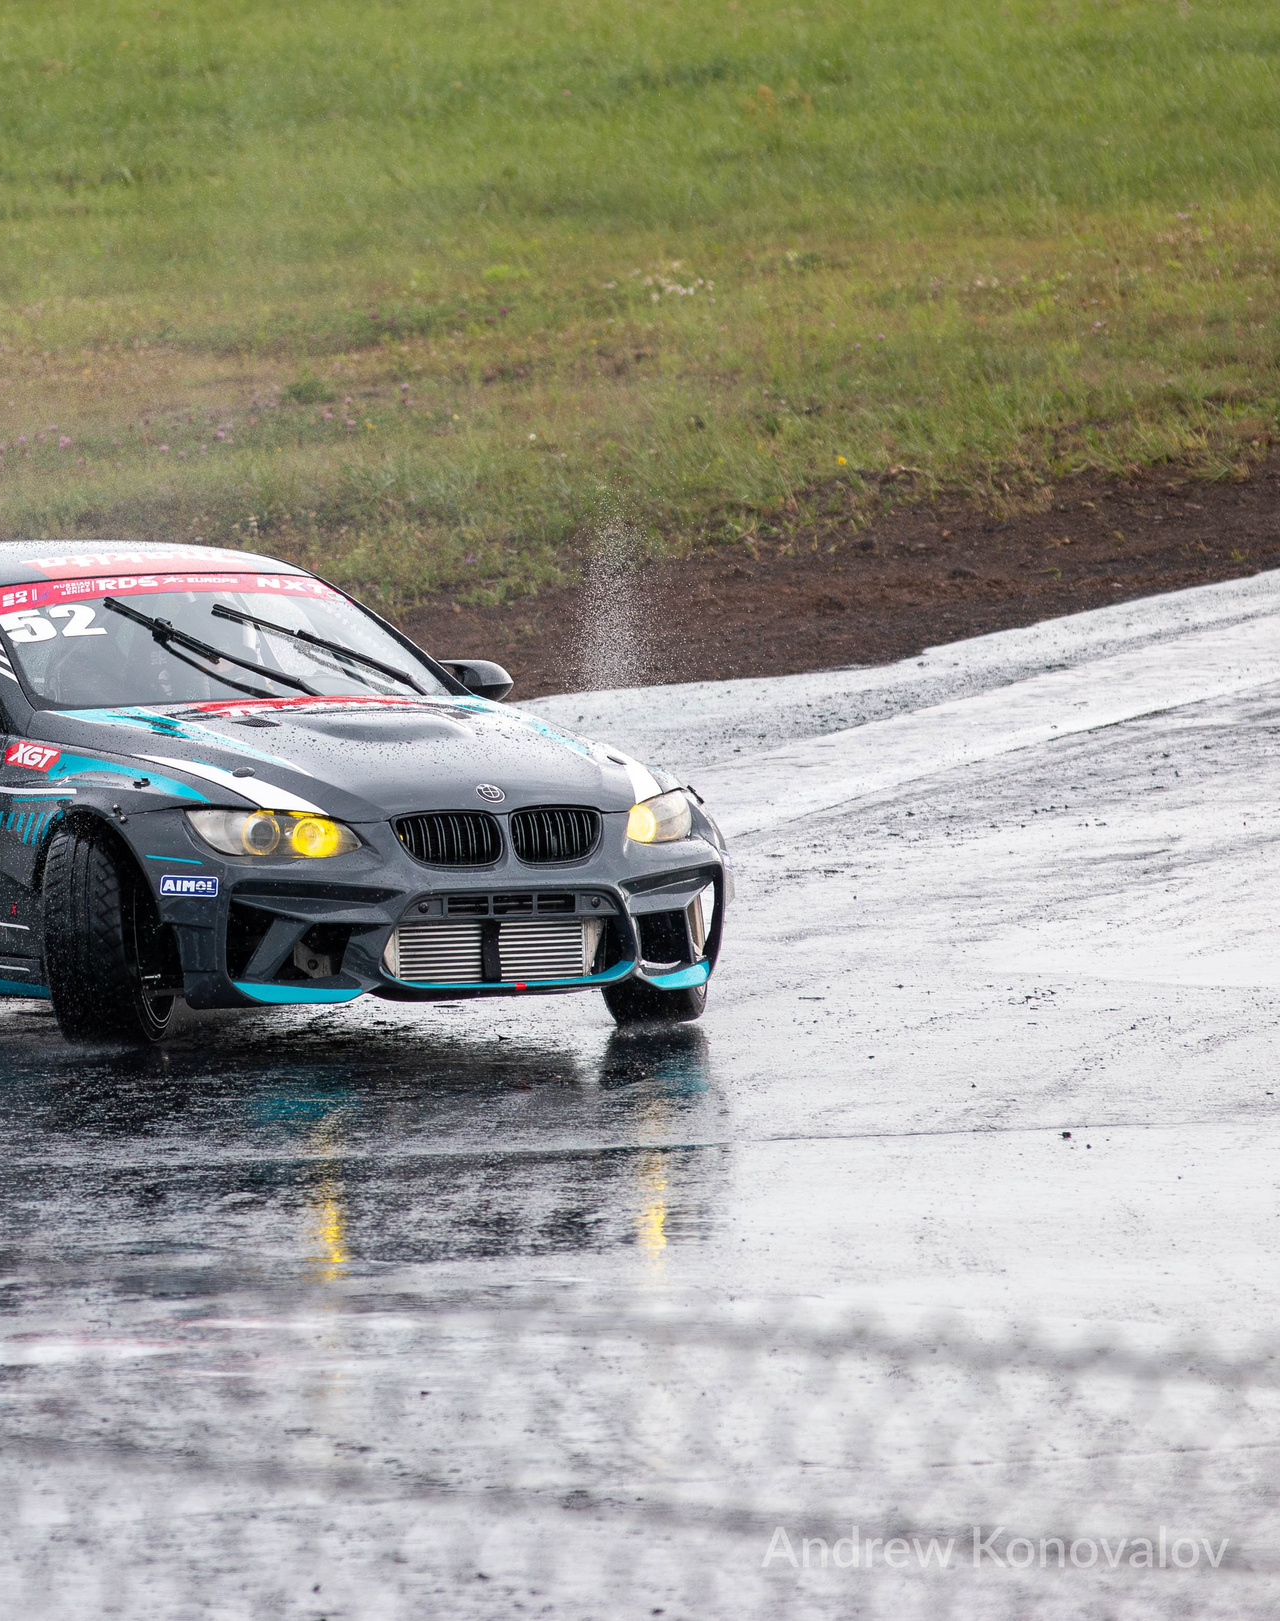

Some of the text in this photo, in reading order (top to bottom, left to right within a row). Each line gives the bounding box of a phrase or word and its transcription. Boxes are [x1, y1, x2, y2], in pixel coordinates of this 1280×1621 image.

[96, 576, 159, 591] RDS
[256, 577, 328, 594] NXT
[8, 743, 59, 768] XGT
[163, 880, 215, 893] AIMOL
